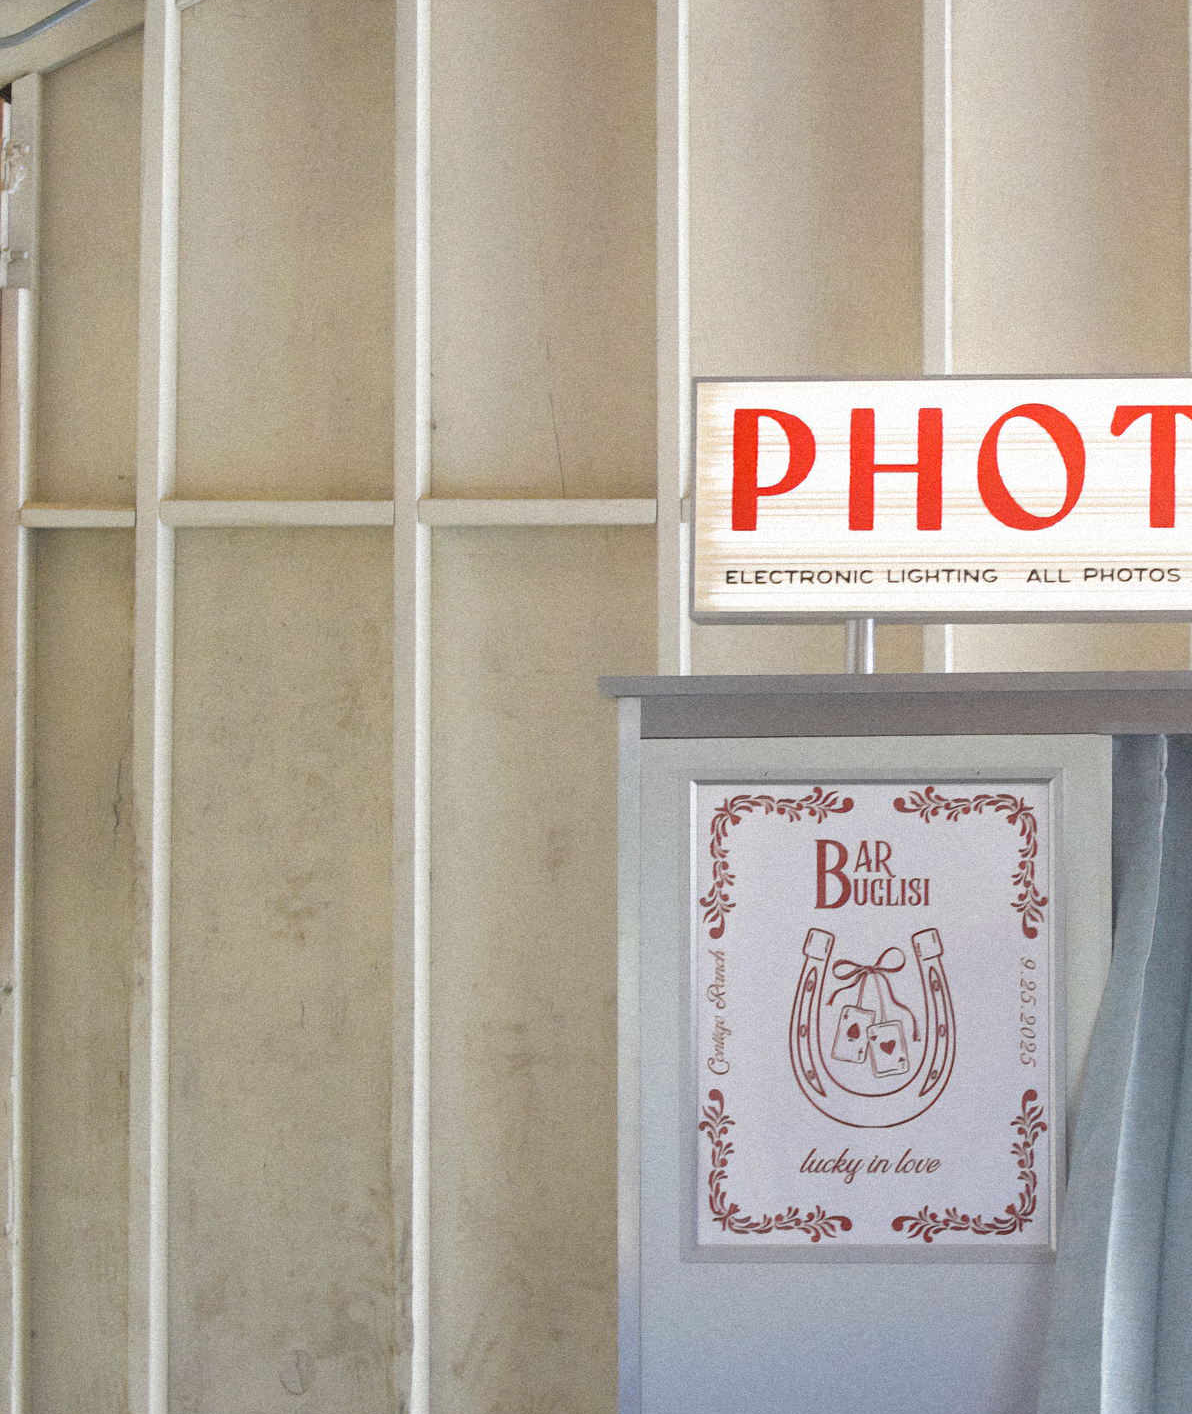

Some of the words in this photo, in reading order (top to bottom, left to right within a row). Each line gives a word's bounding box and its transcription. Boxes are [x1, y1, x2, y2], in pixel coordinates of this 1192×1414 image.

[725, 569, 873, 585] ELECTRONIC
[887, 568, 998, 584] LIGHTING
[1026, 568, 1069, 583] ALL
[1083, 567, 1181, 583] PHOTOS
[706, 950, 727, 1010] Ranch
[1019, 956, 1037, 1068] 9.25.2025
[800, 1147, 865, 1185] lucky
[867, 1154, 892, 1174] in
[894, 1147, 942, 1174] love
